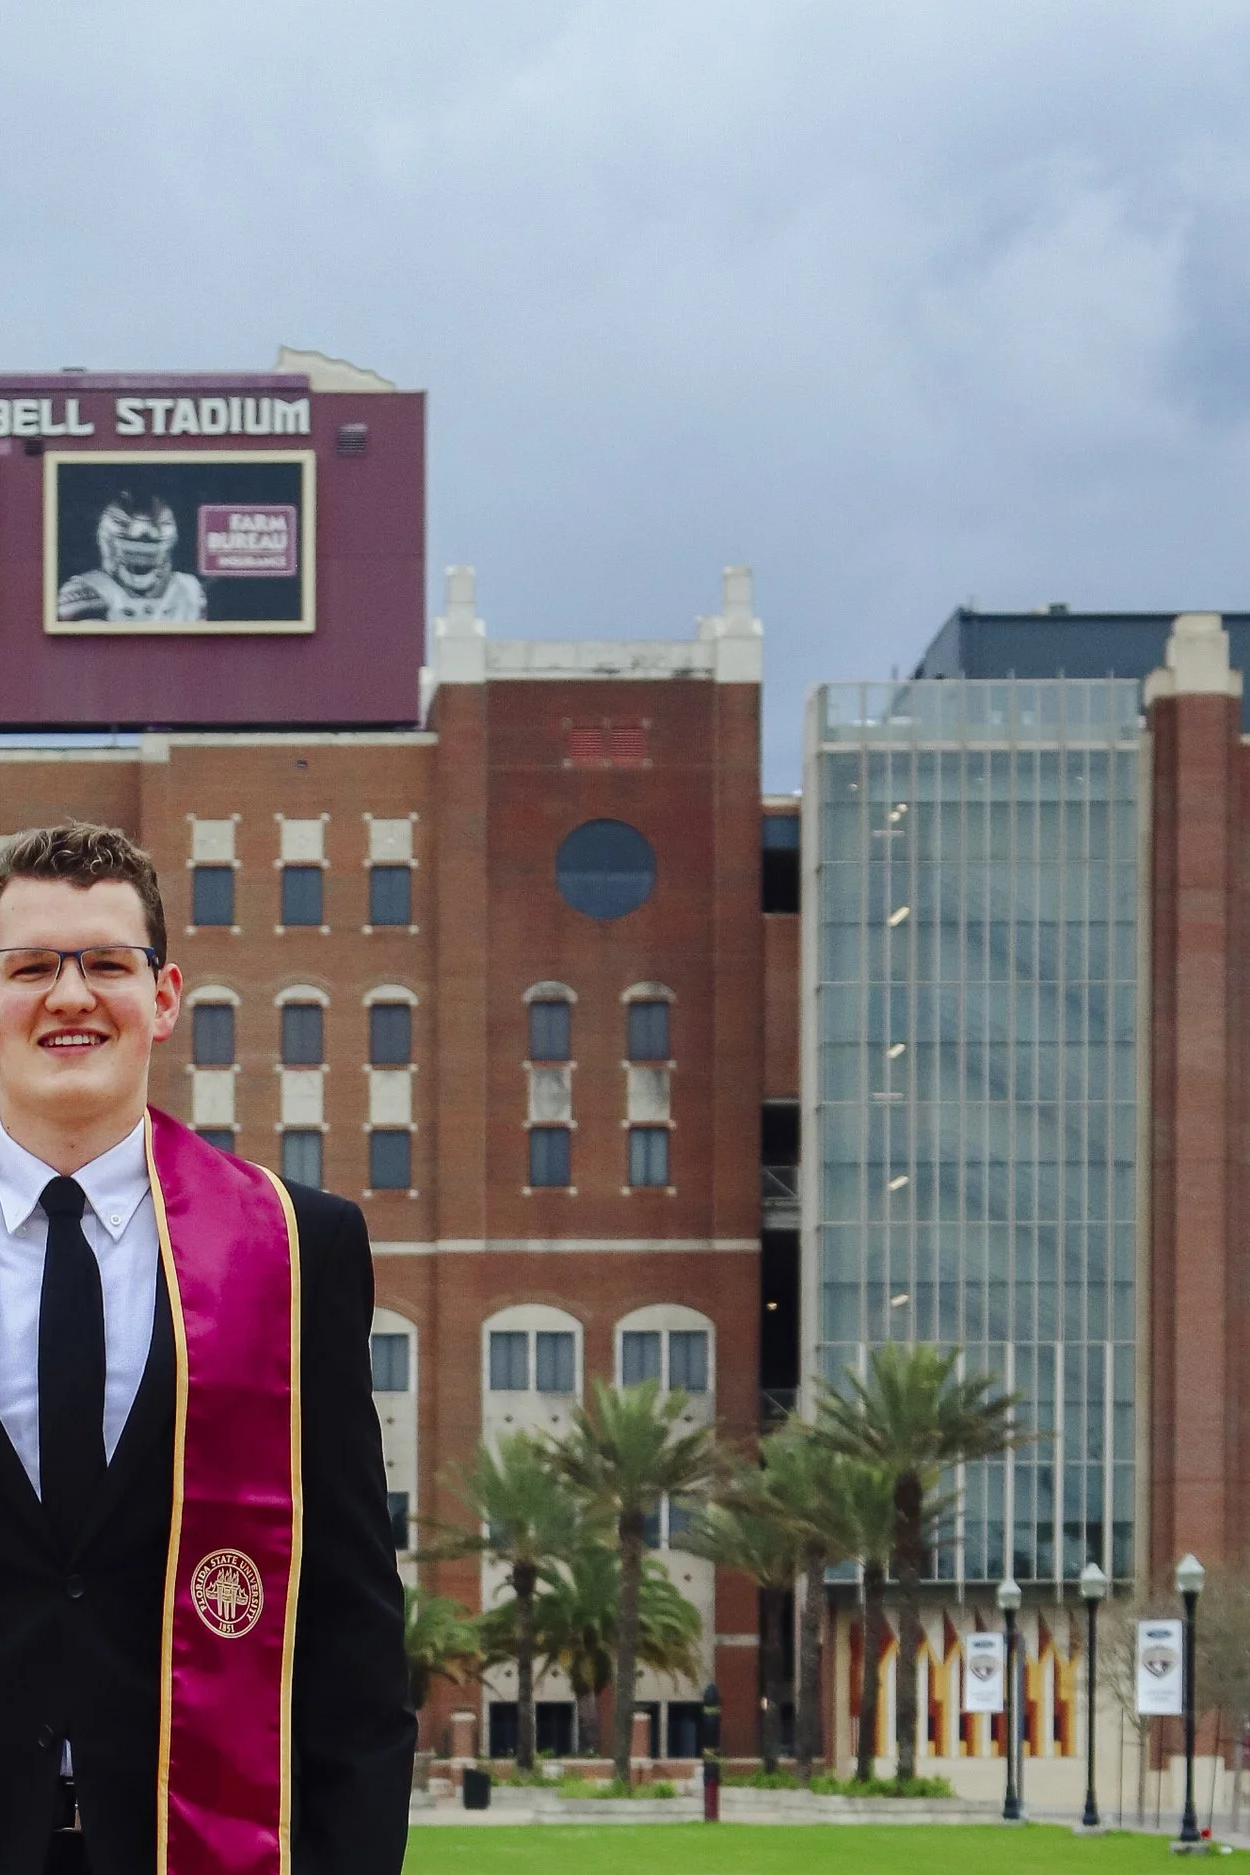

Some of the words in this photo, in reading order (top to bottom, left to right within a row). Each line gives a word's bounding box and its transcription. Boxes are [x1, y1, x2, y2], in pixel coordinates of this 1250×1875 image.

[115, 396, 310, 435] STADIUM
[230, 513, 288, 531] FARM
[207, 532, 288, 549] BUREAU
[196, 1566, 211, 1612] FLORIDA
[211, 1555, 238, 1566] STATE
[240, 1561, 258, 1622] UNIVERSITY
[219, 1622, 235, 1632] 1851
